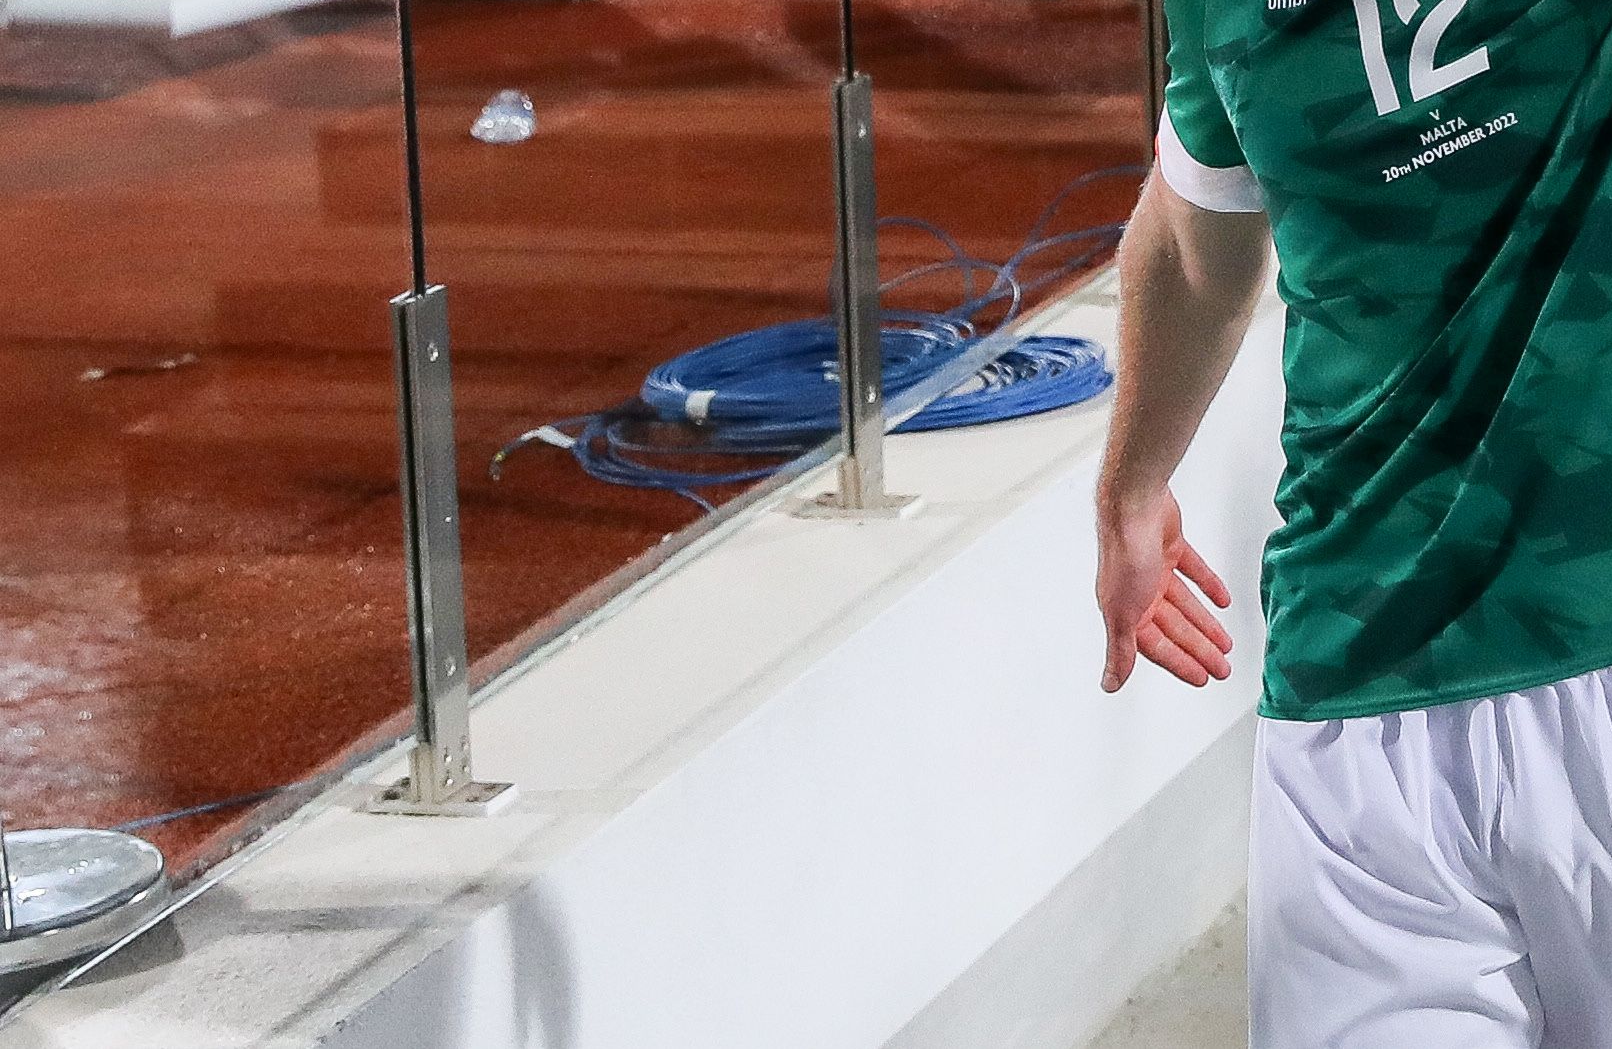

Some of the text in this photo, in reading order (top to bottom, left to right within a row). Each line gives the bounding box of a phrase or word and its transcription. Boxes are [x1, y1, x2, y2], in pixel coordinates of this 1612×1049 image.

[1411, 127, 1487, 170] NOVEMBER
[1484, 112, 1519, 136] 2022
[1419, 116, 1468, 146] MALTA
